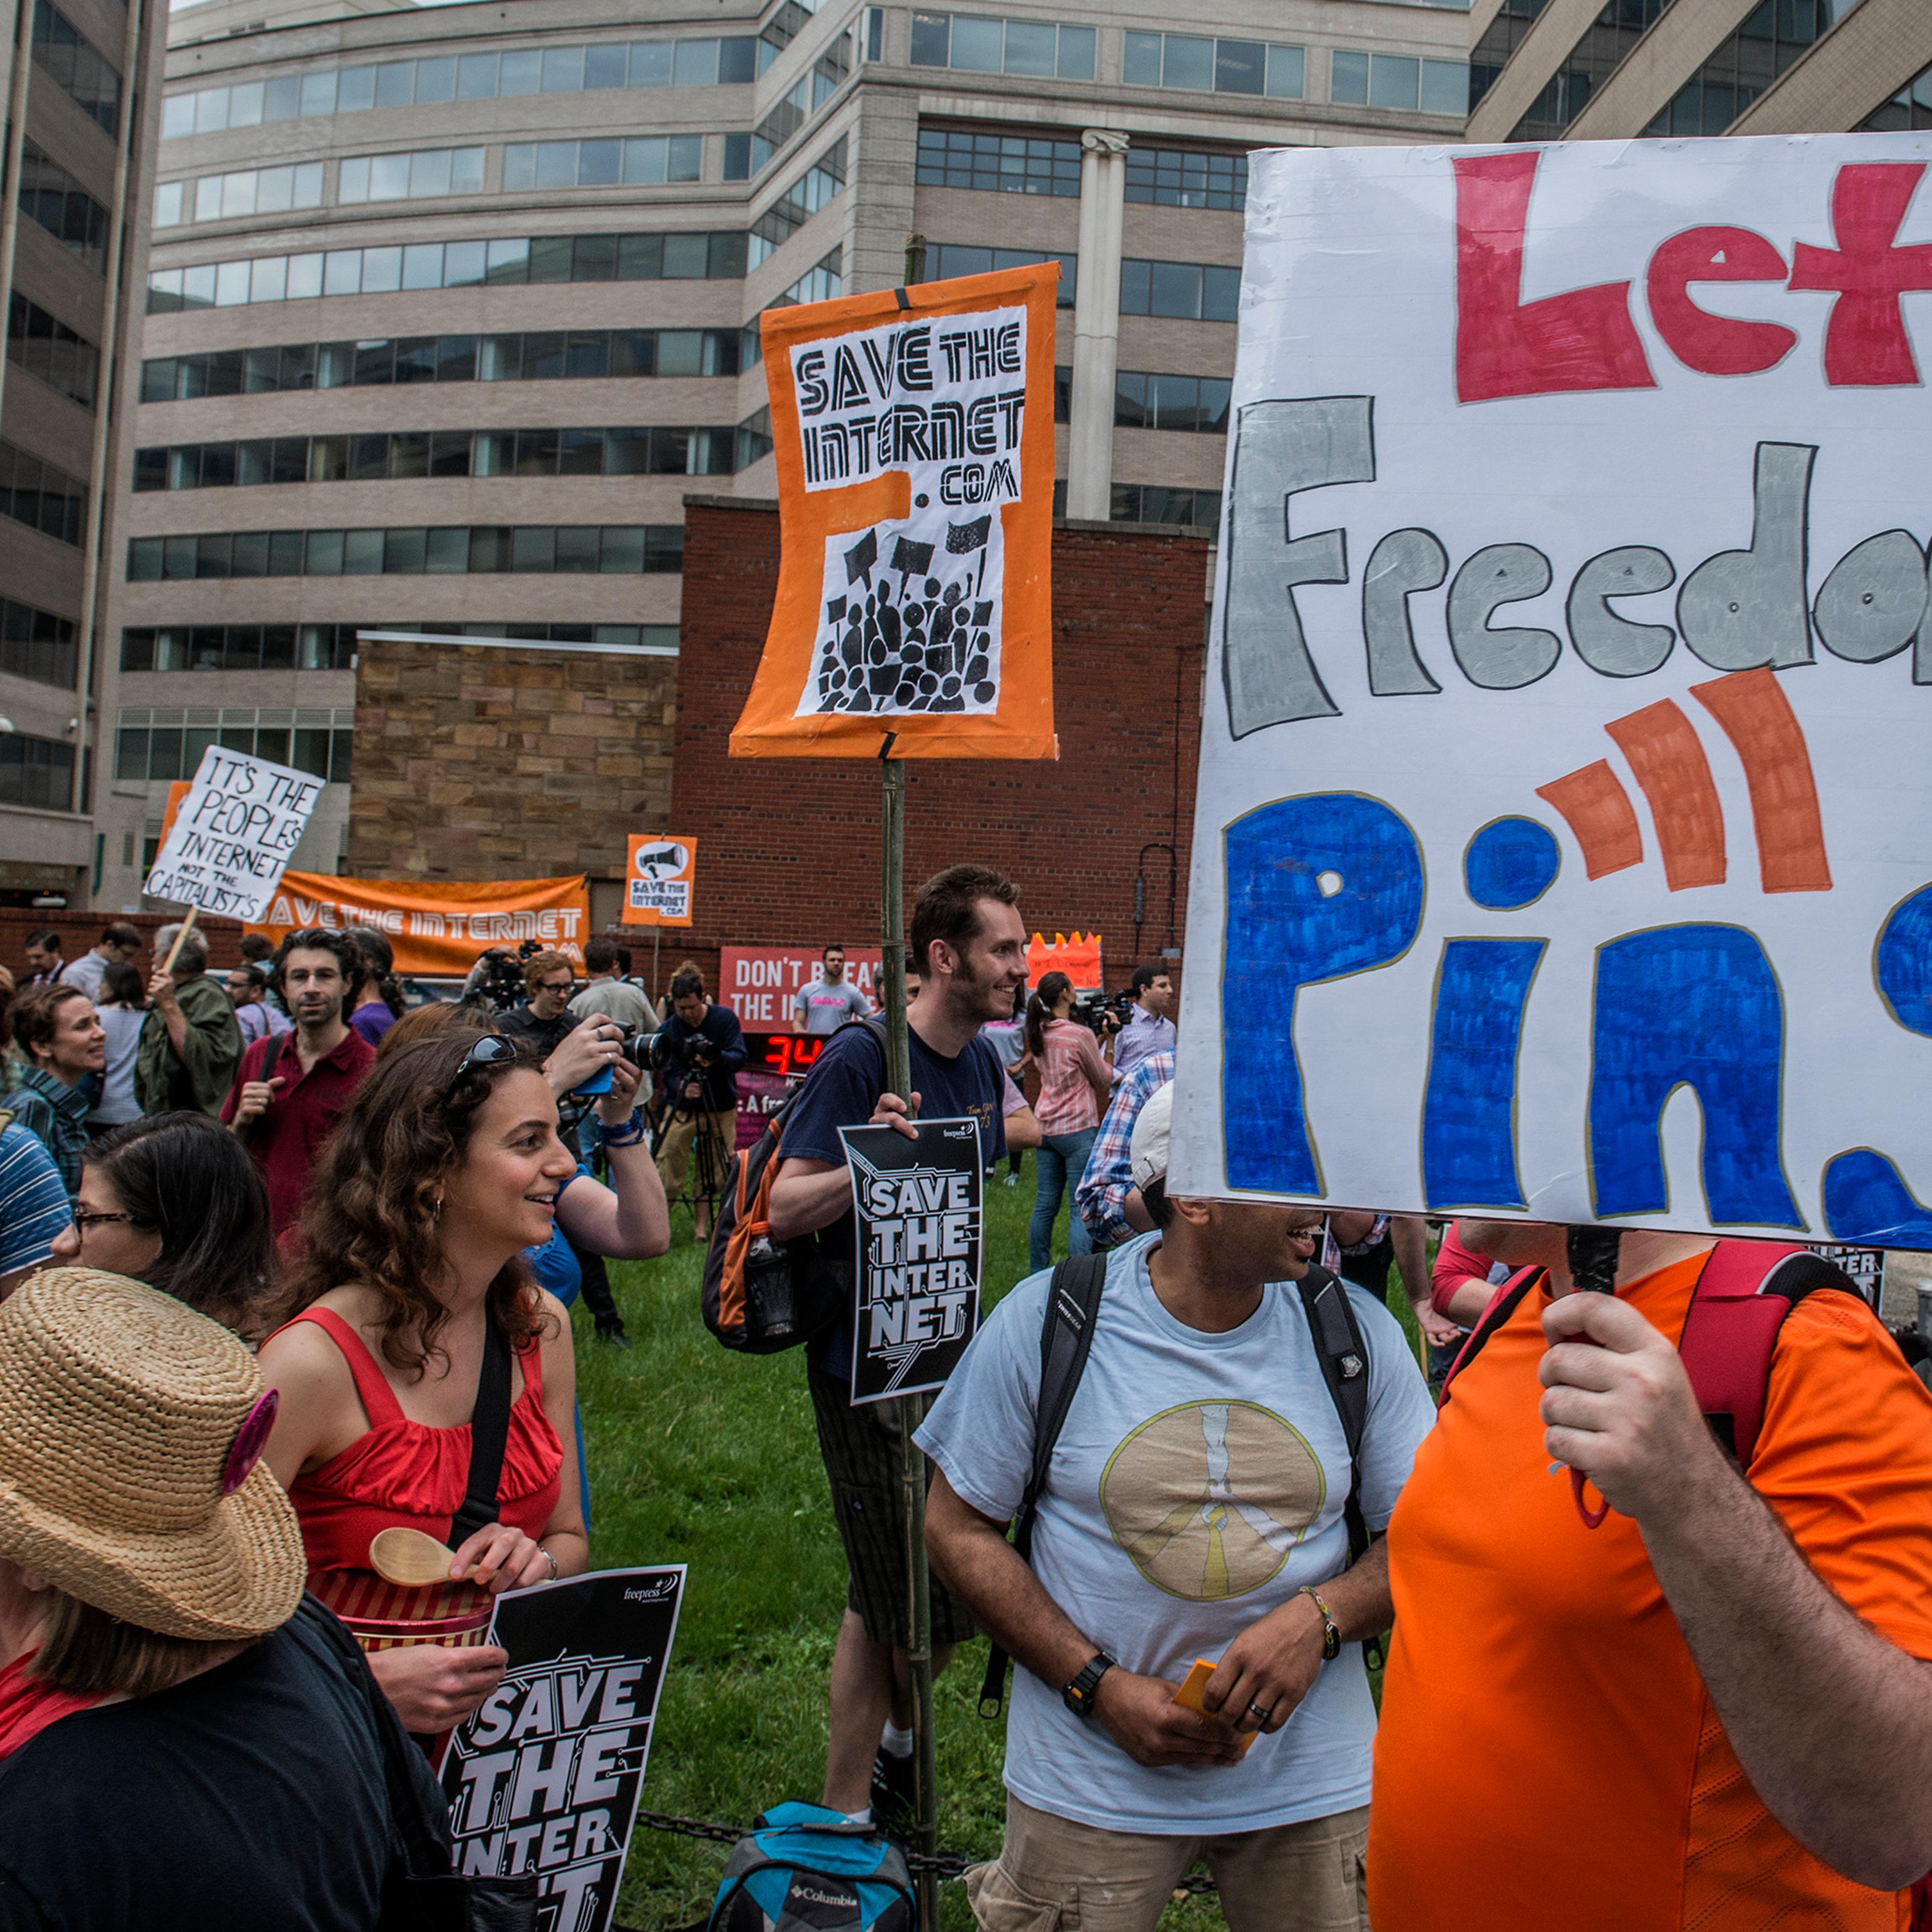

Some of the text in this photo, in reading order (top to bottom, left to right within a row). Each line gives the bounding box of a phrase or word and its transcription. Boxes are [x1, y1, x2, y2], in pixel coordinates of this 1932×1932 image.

[1451, 151, 1932, 406] Let
[796, 322, 1020, 417] SAVE THE
[803, 388, 1025, 483] INTERNET
[1222, 395, 1932, 741] Freedo
[206, 756, 318, 816] IT'S THE
[192, 789, 302, 851] PEOPLE'S
[178, 831, 288, 879] INTERNET
[178, 863, 238, 888] NOT THE
[147, 870, 259, 918] CAPITALIST'S
[632, 895, 686, 907] INTERNET
[633, 881, 685, 894] SAVE THE
[340, 904, 404, 935] THE
[410, 908, 582, 940] INTERNET
[736, 957, 802, 988] DON'T
[730, 993, 773, 1021] THE
[746, 1094, 759, 1113] A
[870, 1175, 970, 1217] SAVE
[871, 1213, 969, 1264] THE
[872, 1259, 968, 1299] INTER
[869, 1292, 968, 1349] NET
[623, 1587, 661, 1602] freepress
[470, 1664, 643, 1747] SAVE
[461, 1728, 630, 1831] THE
[802, 1887, 857, 1906] Columbia
